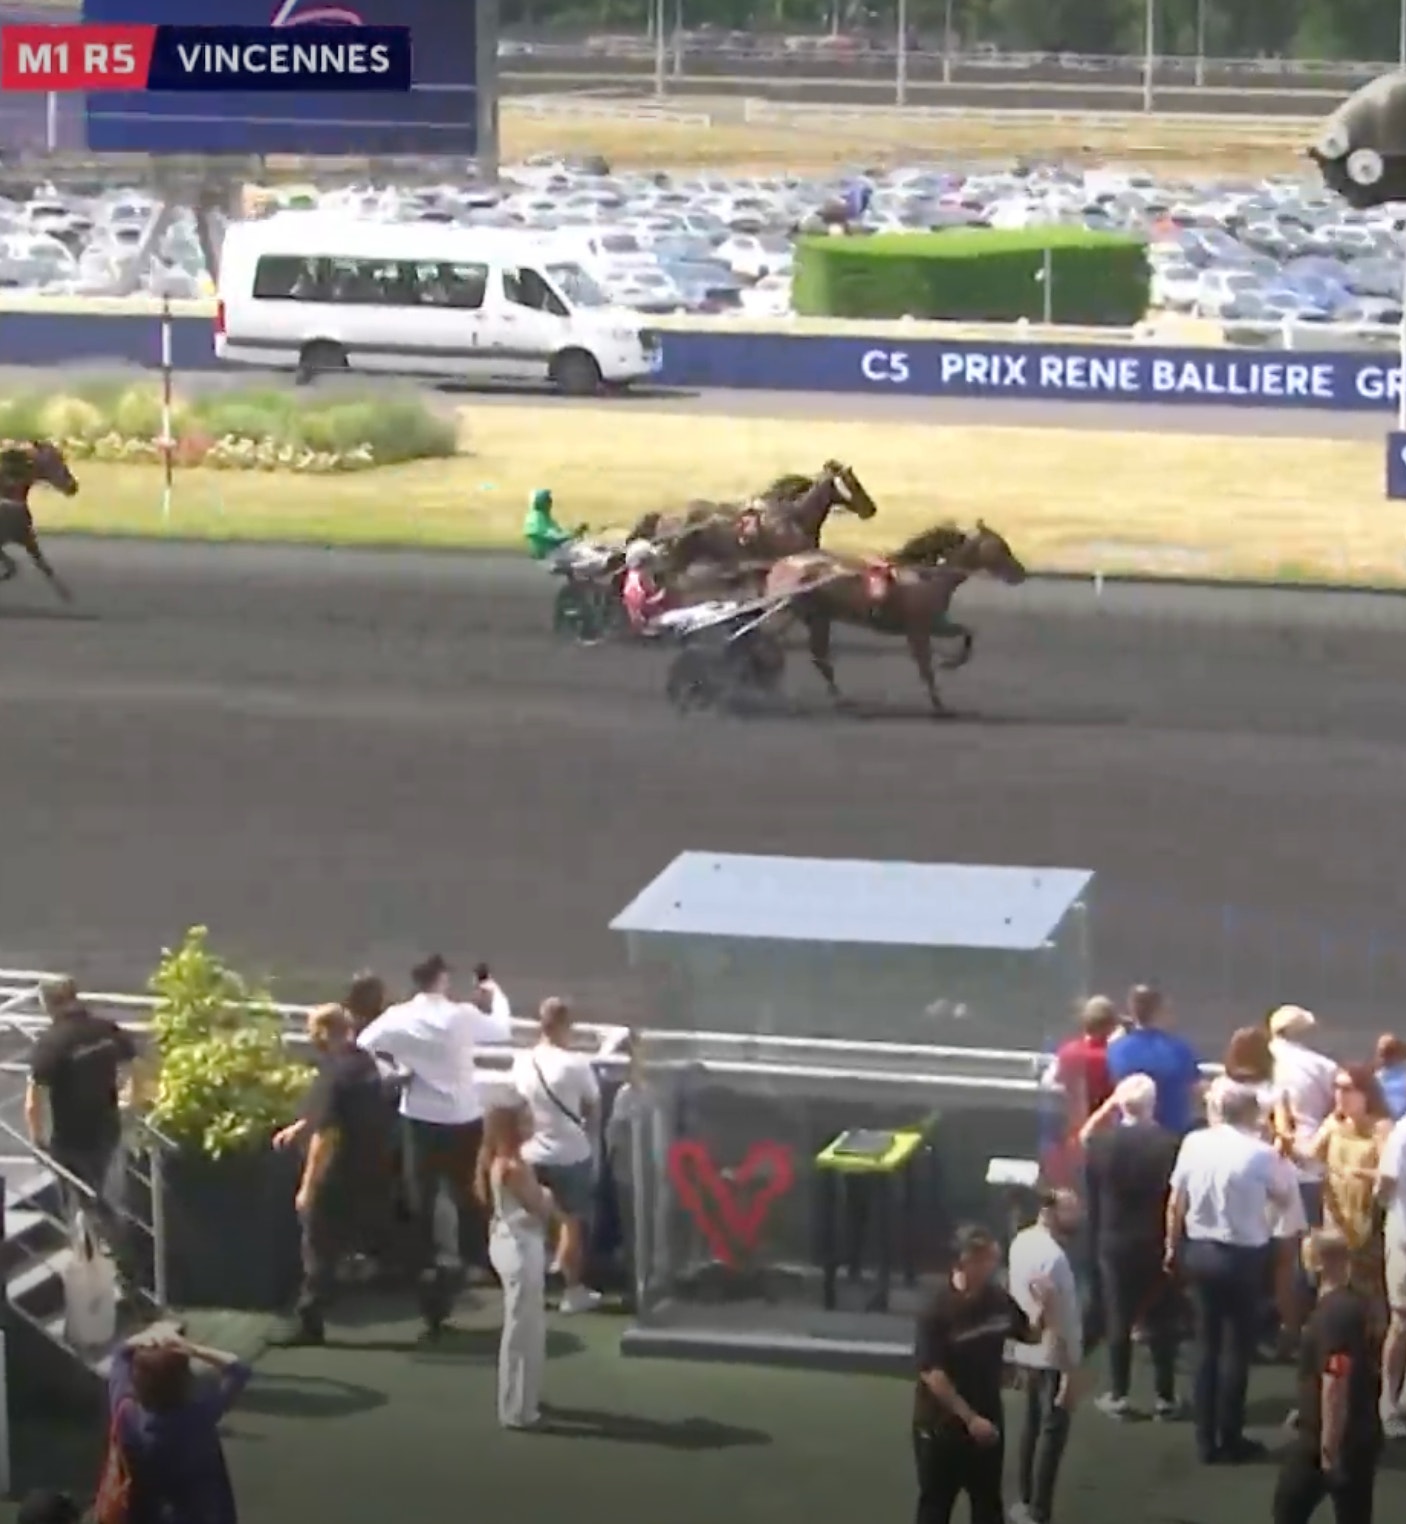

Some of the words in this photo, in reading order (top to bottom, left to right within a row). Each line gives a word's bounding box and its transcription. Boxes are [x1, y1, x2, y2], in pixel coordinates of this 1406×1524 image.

[860, 350, 911, 383] C5
[940, 353, 1028, 386] PRIX
[1040, 356, 1141, 391] RENE
[1151, 359, 1335, 396] BALLIERE
